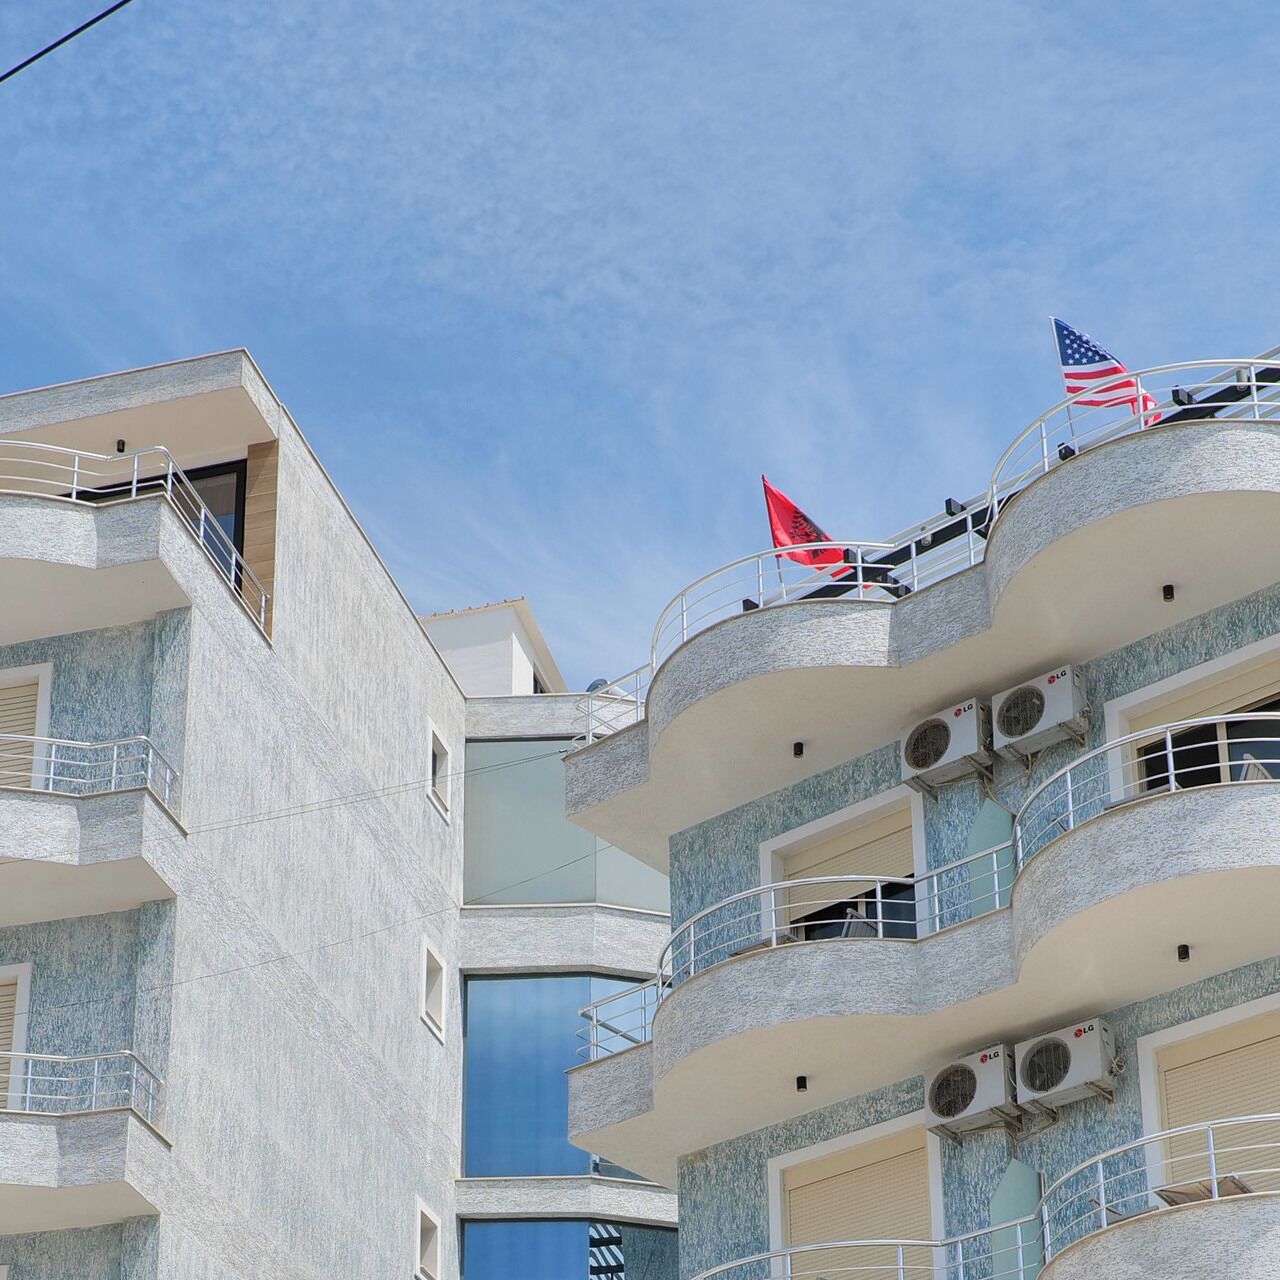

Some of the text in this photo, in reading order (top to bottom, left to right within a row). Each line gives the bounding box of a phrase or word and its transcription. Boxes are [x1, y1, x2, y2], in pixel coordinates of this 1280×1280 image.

[1056, 670, 1067, 679] LG
[963, 703, 973, 713] LG
[1083, 1024, 1095, 1034] LG
[989, 1051, 1000, 1060] LG
